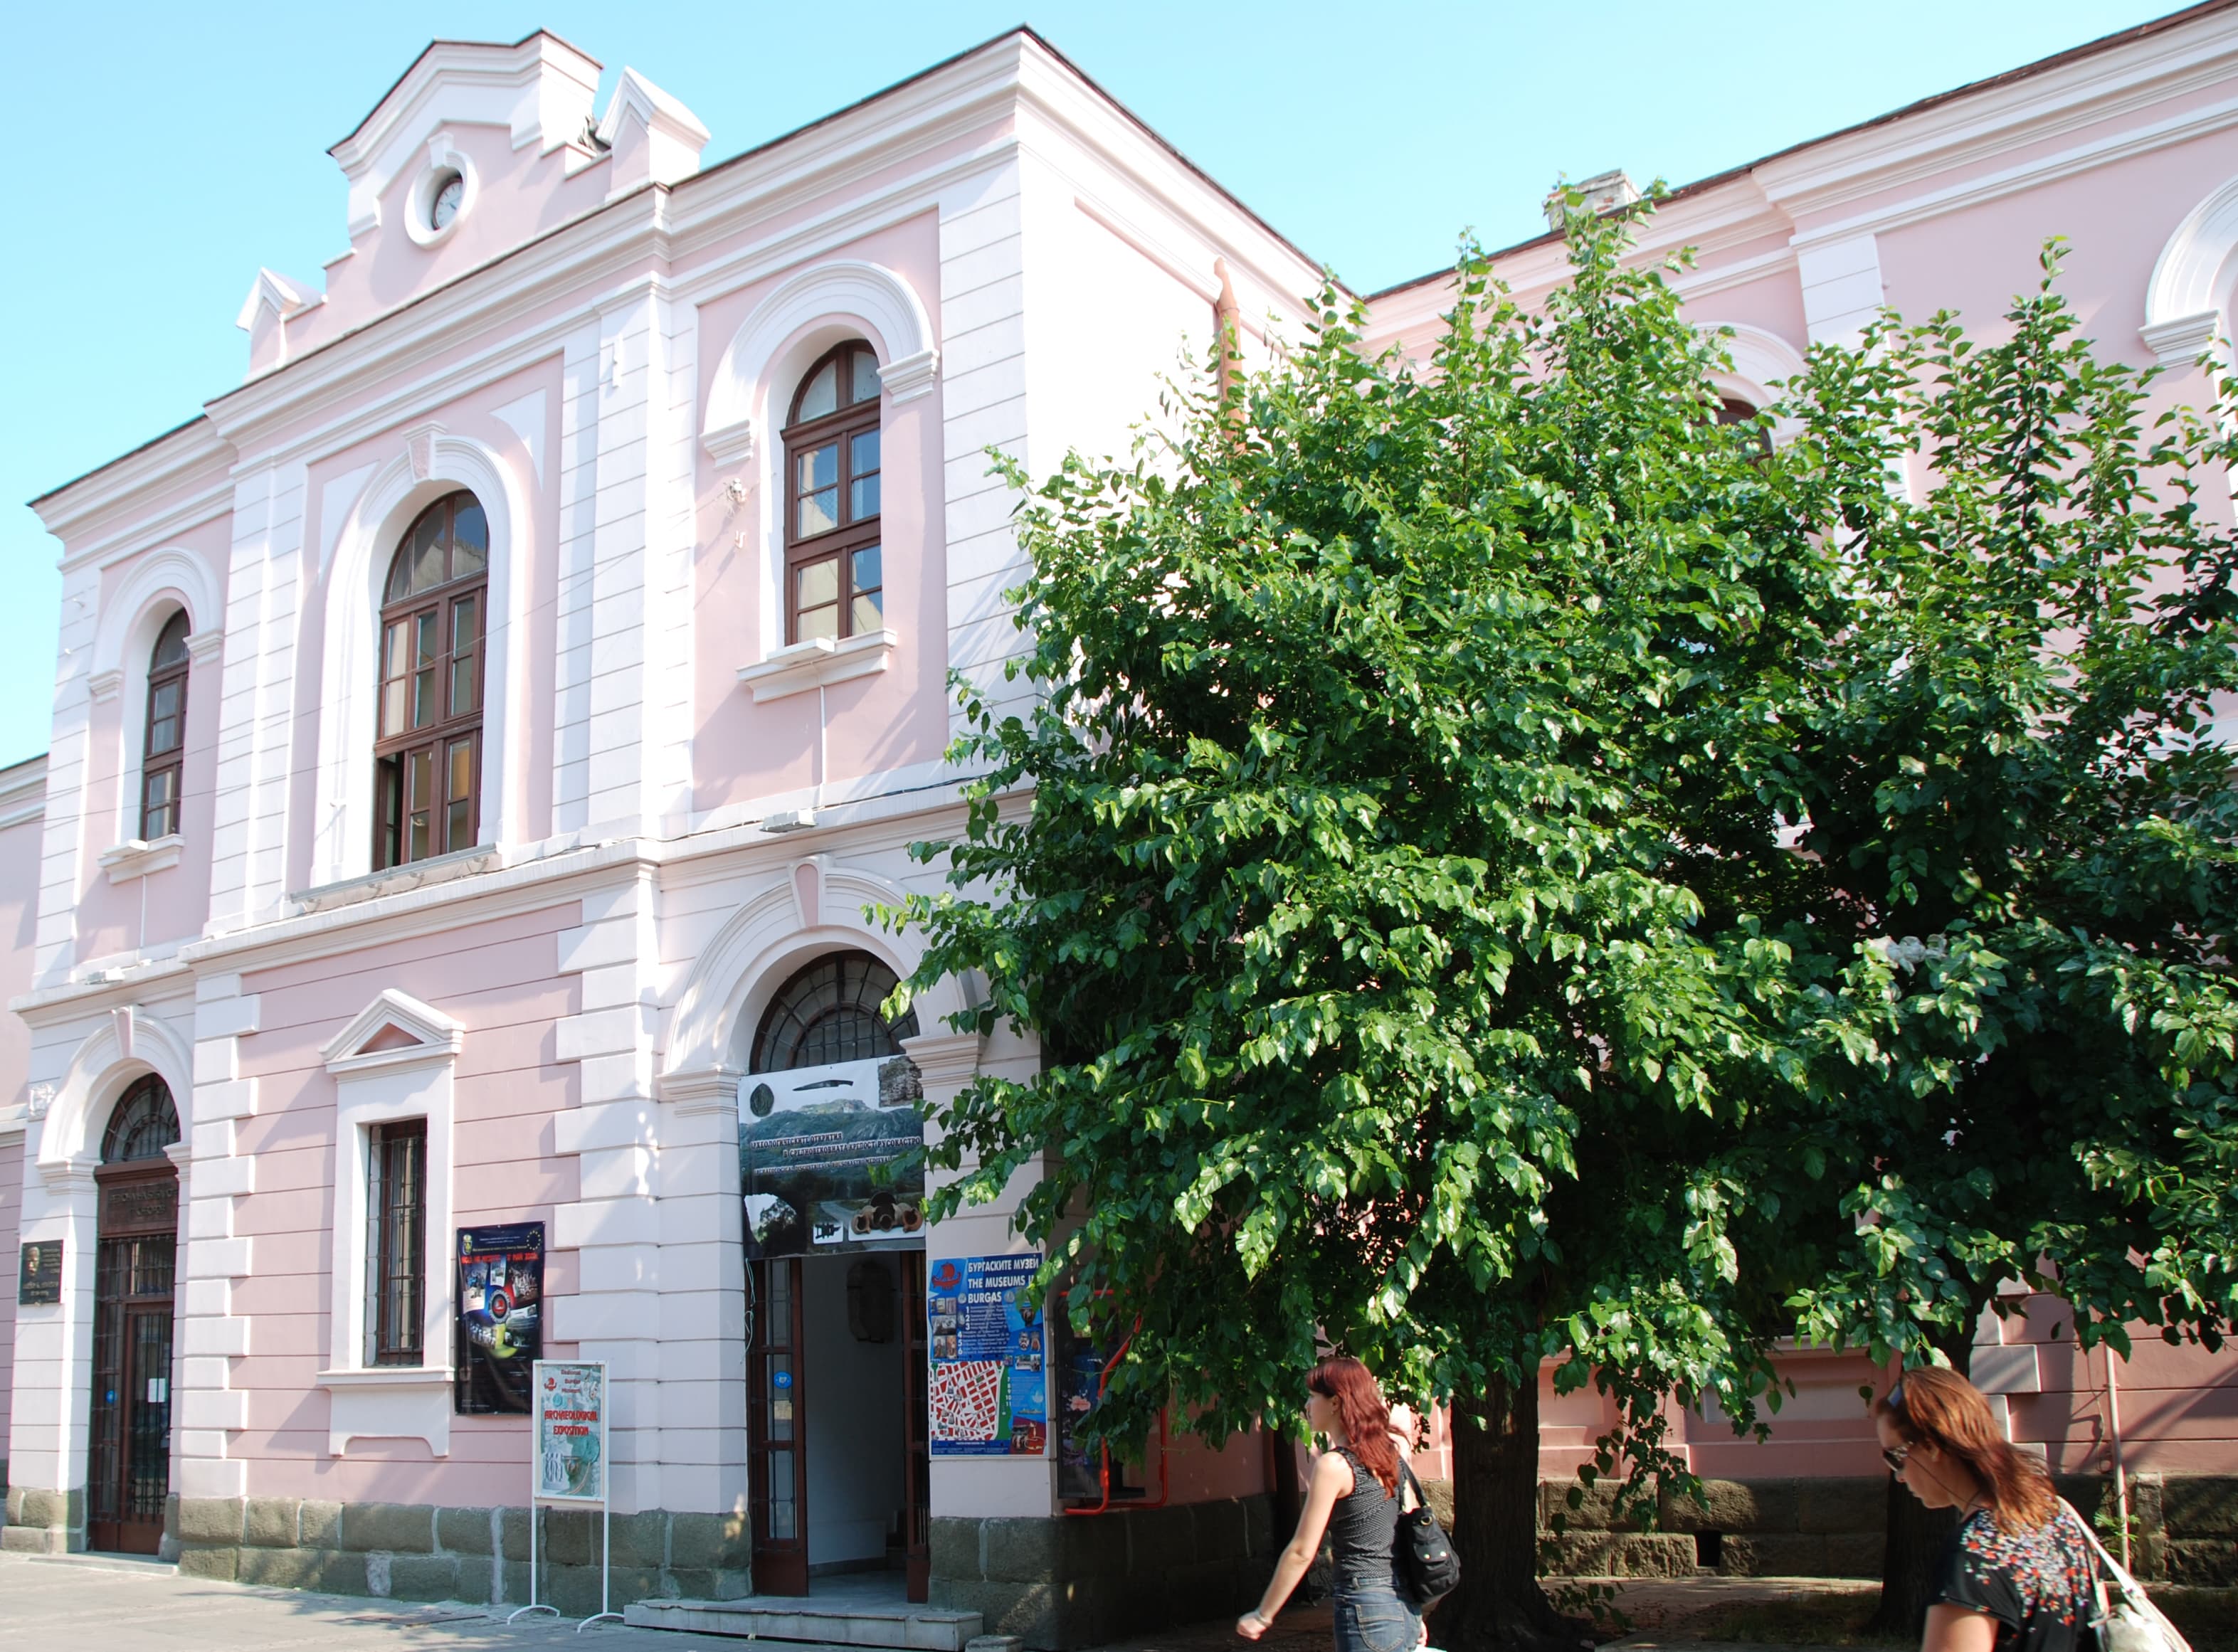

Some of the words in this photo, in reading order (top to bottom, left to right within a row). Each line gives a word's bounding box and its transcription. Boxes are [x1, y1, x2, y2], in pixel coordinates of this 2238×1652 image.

[877, 1136, 922, 1148] РУСОКАСТРО
[968, 1260, 1012, 1273] БУРГАСКИТЕ
[968, 1278, 983, 1289] THE
[985, 1275, 1025, 1288] MUSEUMS
[968, 1291, 1002, 1304] BURGAS
[958, 1347, 963, 1355] 6
[544, 1410, 598, 1421] ARCHAEOLOGICAL
[553, 1425, 589, 1436] EXPOSITION
